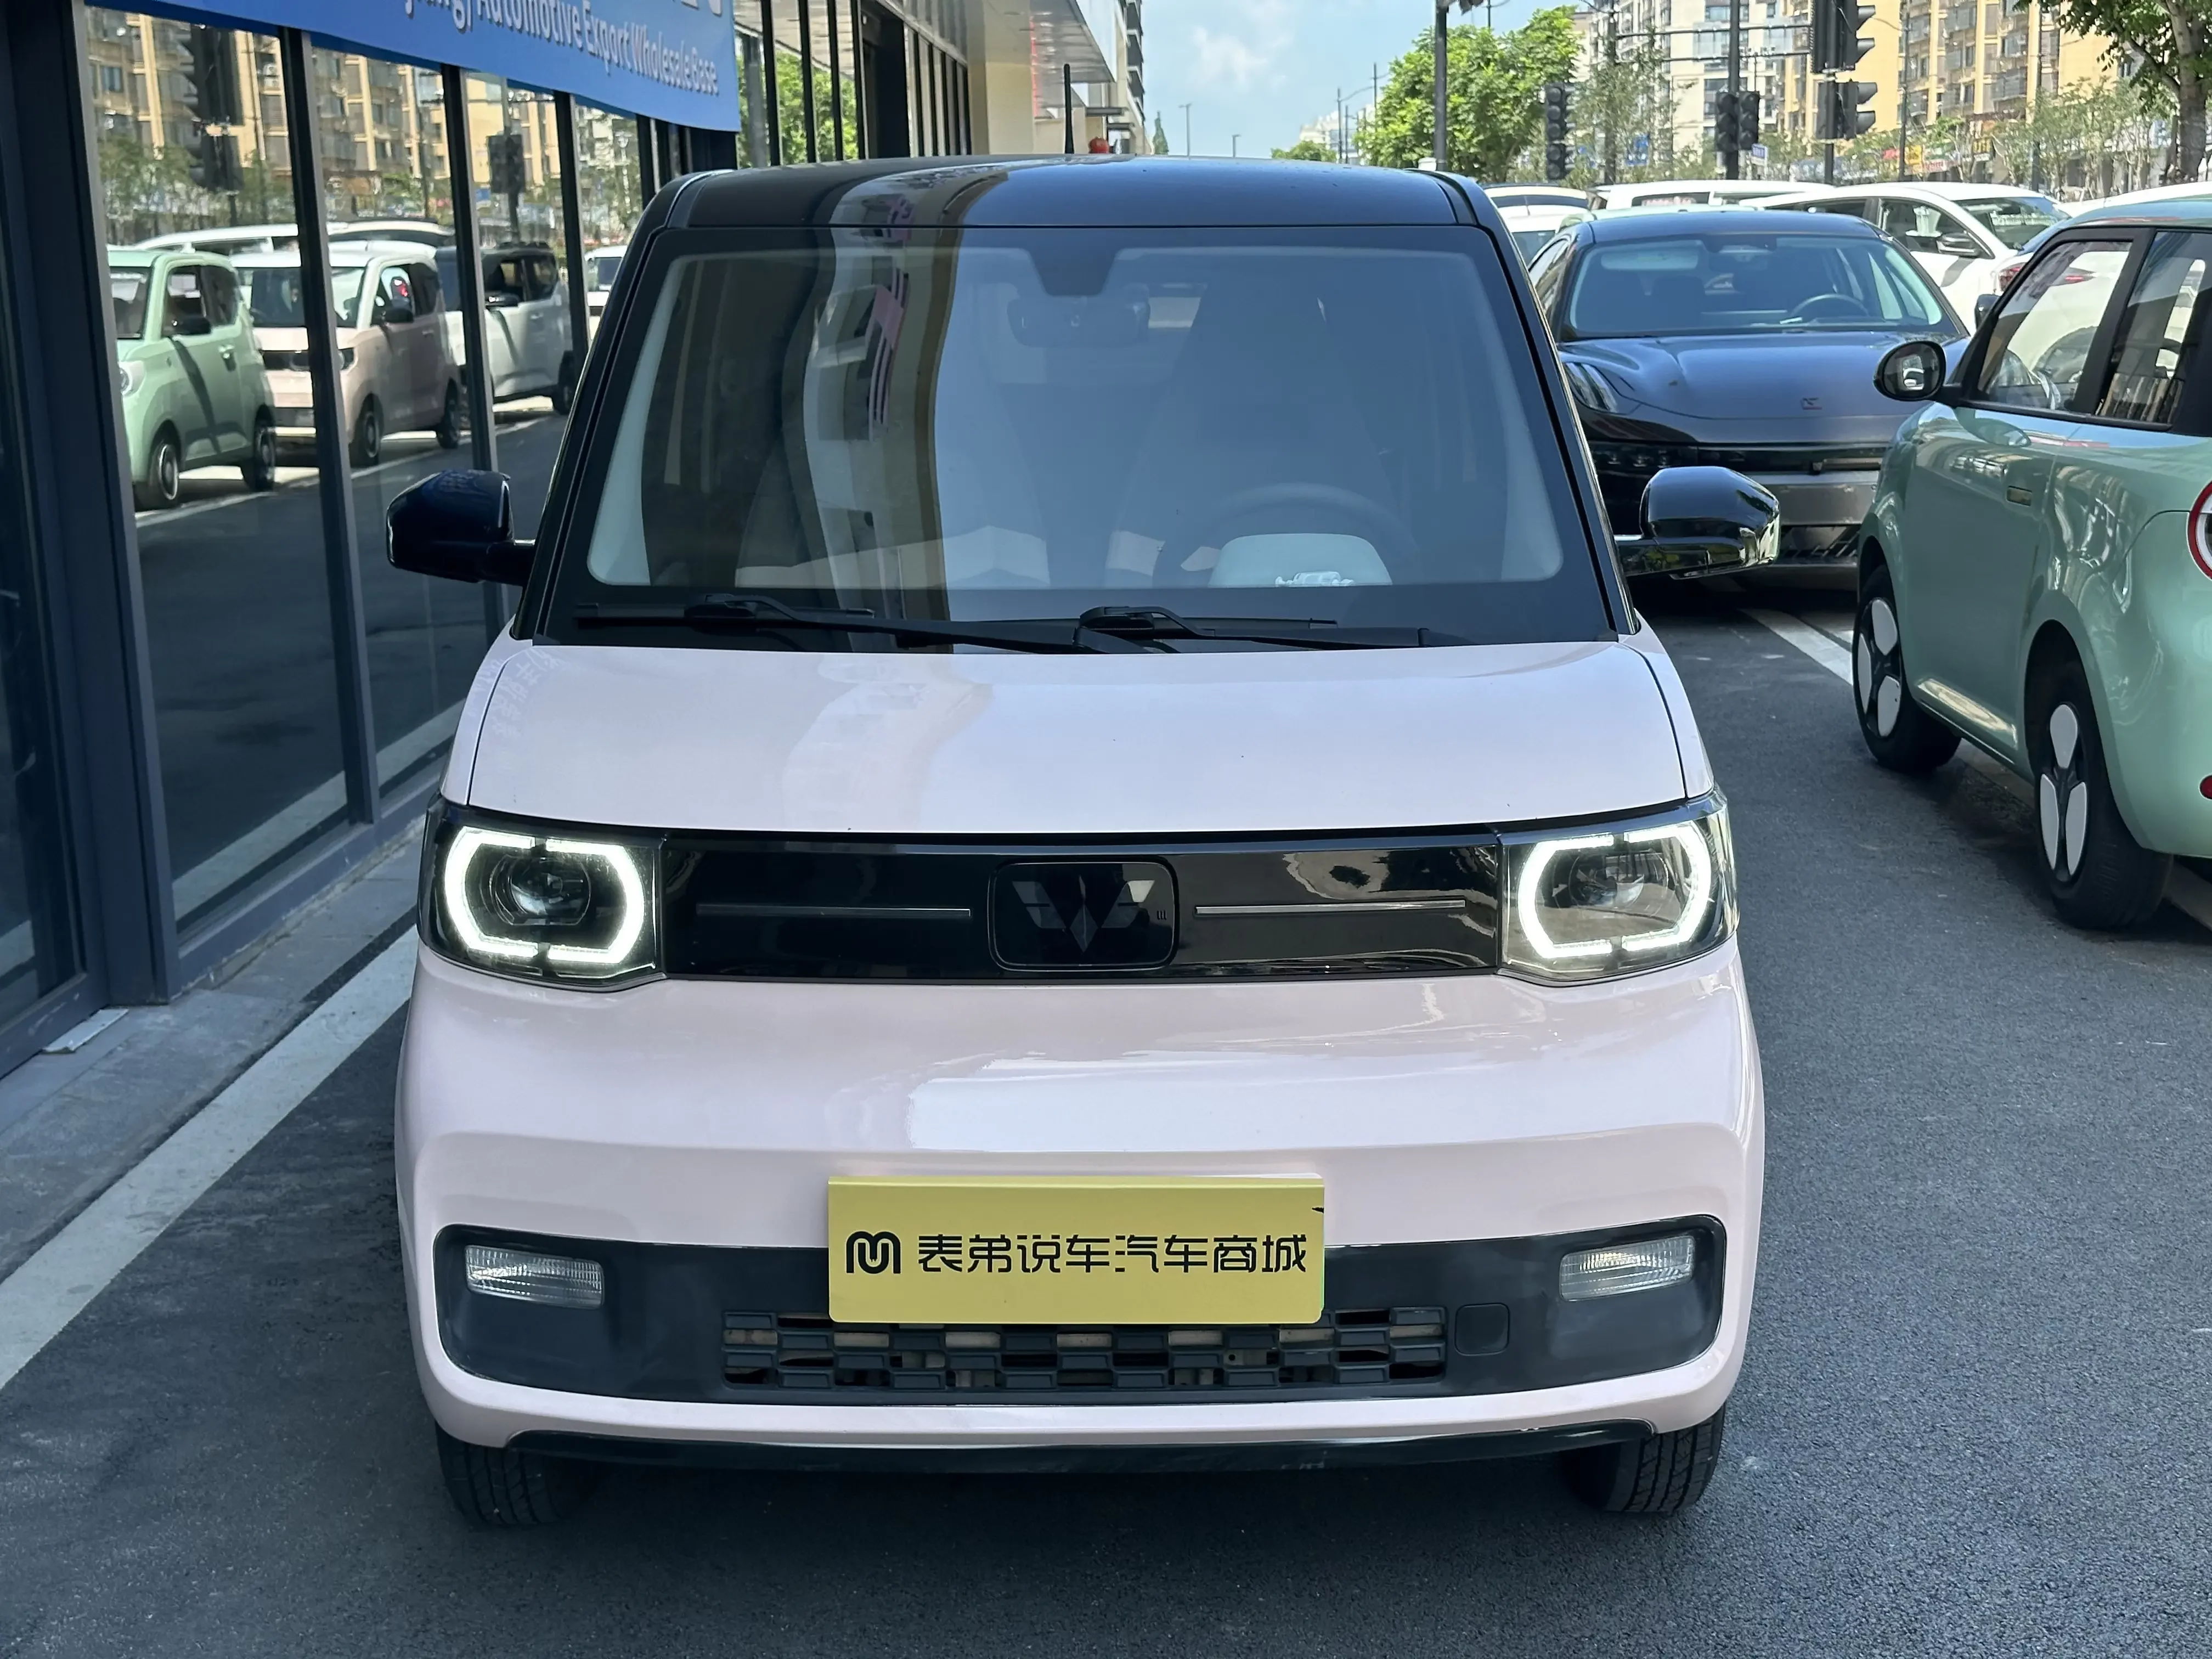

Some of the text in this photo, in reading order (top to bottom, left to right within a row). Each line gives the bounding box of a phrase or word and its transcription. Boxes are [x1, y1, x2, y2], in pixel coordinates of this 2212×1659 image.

[583, 0, 631, 74] Export
[631, 22, 692, 89] Wholesale
[692, 47, 718, 94] Base
[918, 1234, 1307, 1273] 表弟说车汽车商城
